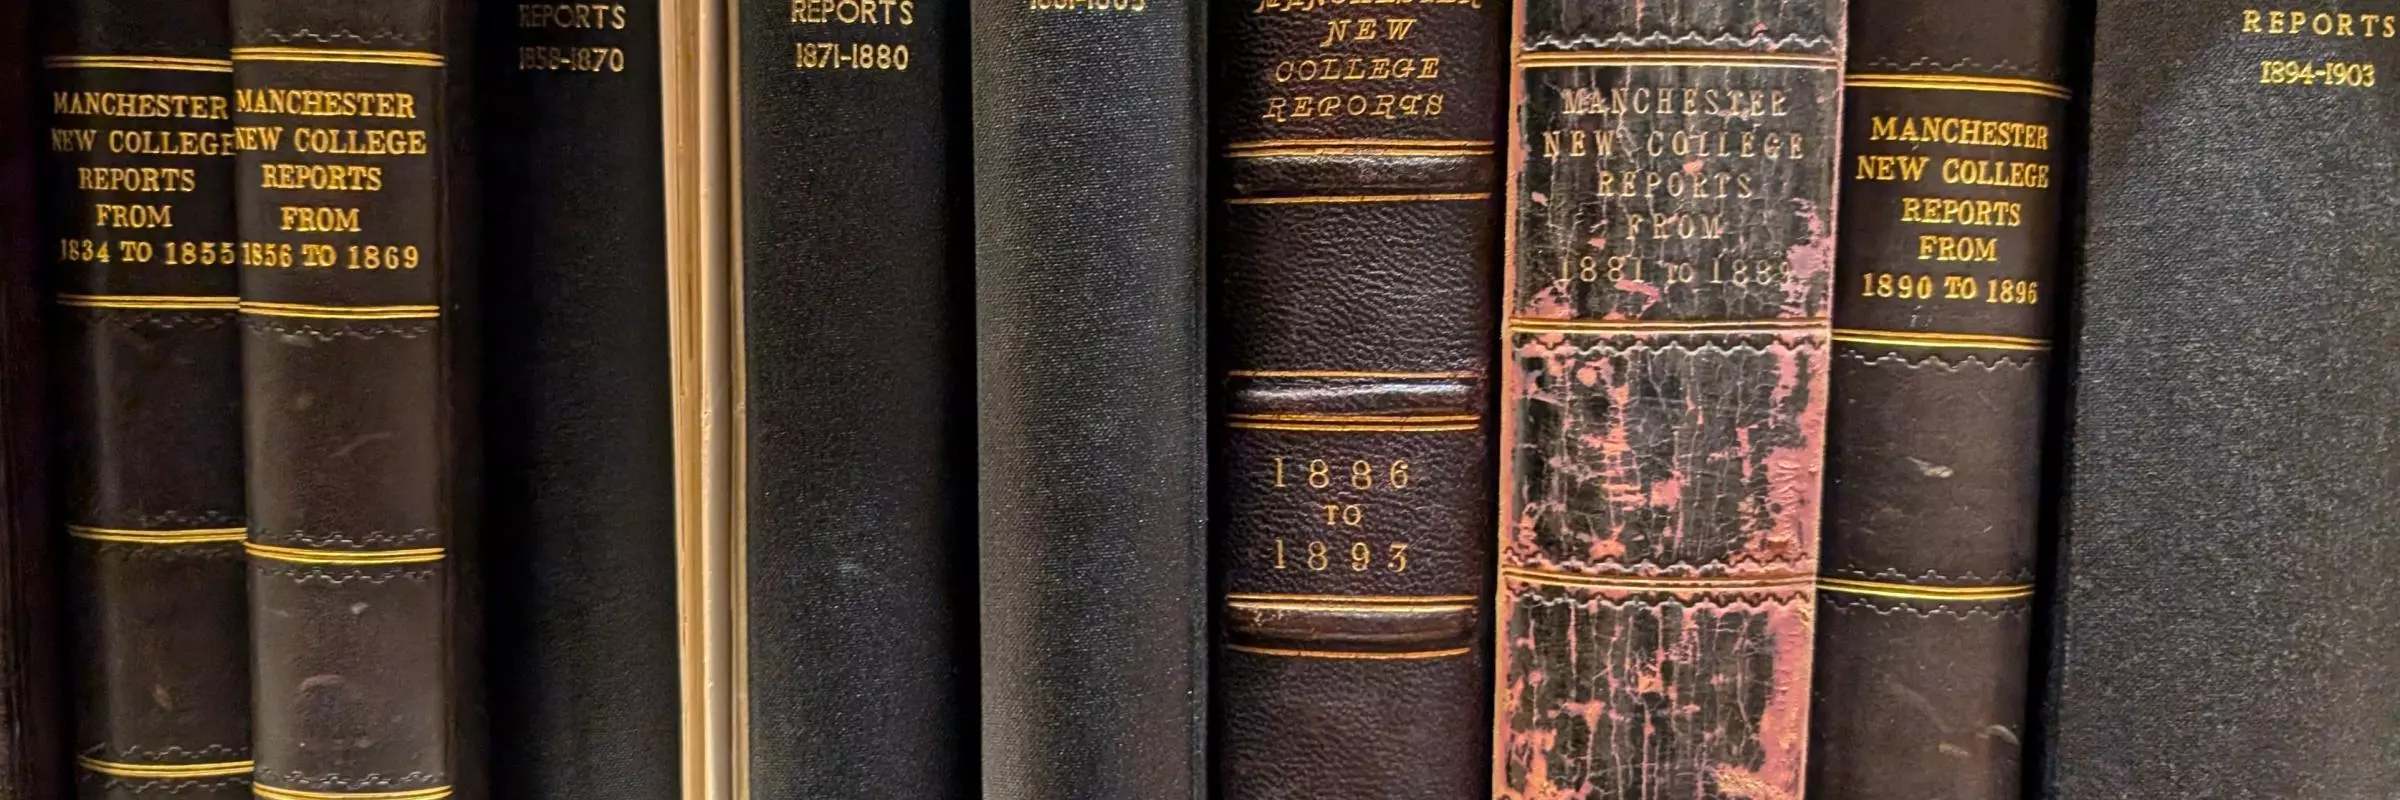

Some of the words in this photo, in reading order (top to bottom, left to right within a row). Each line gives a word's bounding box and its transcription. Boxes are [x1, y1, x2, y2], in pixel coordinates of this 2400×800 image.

[518, 4, 626, 29] REPORTS
[791, 0, 914, 25] REPORTS
[2241, 9, 2397, 38] REPORTS
[1319, 18, 1416, 48] NEW
[795, 42, 909, 70] 1871-1880
[1275, 57, 1440, 83] COLLEGE
[2260, 60, 2375, 87] 1894-1903
[53, 91, 229, 120] MANCHESTER
[235, 88, 417, 119] MANCHESTER
[1262, 93, 1444, 122] REPORTS
[1561, 87, 1790, 117] MANCHESTER
[51, 127, 97, 152] NEW
[108, 129, 237, 156] COLLEGE
[234, 126, 284, 151] NEW
[293, 127, 428, 155] COLLEGE
[1543, 129, 1617, 158] NEW
[1646, 130, 1804, 160] COLLEGE
[1870, 115, 2049, 150] MANCHESTER
[78, 167, 196, 192] REPORTS
[261, 163, 382, 192] REPORTS
[1596, 170, 1753, 199] REPORTS
[1855, 155, 1931, 182] NEW
[1941, 157, 2050, 189] COLLEGE
[95, 203, 174, 229] FROM
[280, 206, 362, 232] FROM
[1626, 212, 1723, 240] FROM
[1900, 197, 2022, 227] REPORTS
[60, 238, 110, 263] 1834
[120, 240, 153, 263] TO
[164, 241, 236, 266] 1855
[240, 242, 294, 268] 1856
[302, 243, 338, 268] TO
[347, 245, 420, 270] 1869
[1916, 235, 1998, 262] FROM
[1560, 255, 1645, 284] 1881
[1861, 273, 1934, 300] 1890
[1943, 275, 1979, 300] TO
[1986, 279, 2040, 305] 1896
[1273, 456, 1409, 490] 1886
[1323, 503, 1362, 526] TO
[1273, 536, 1408, 573] 1893
